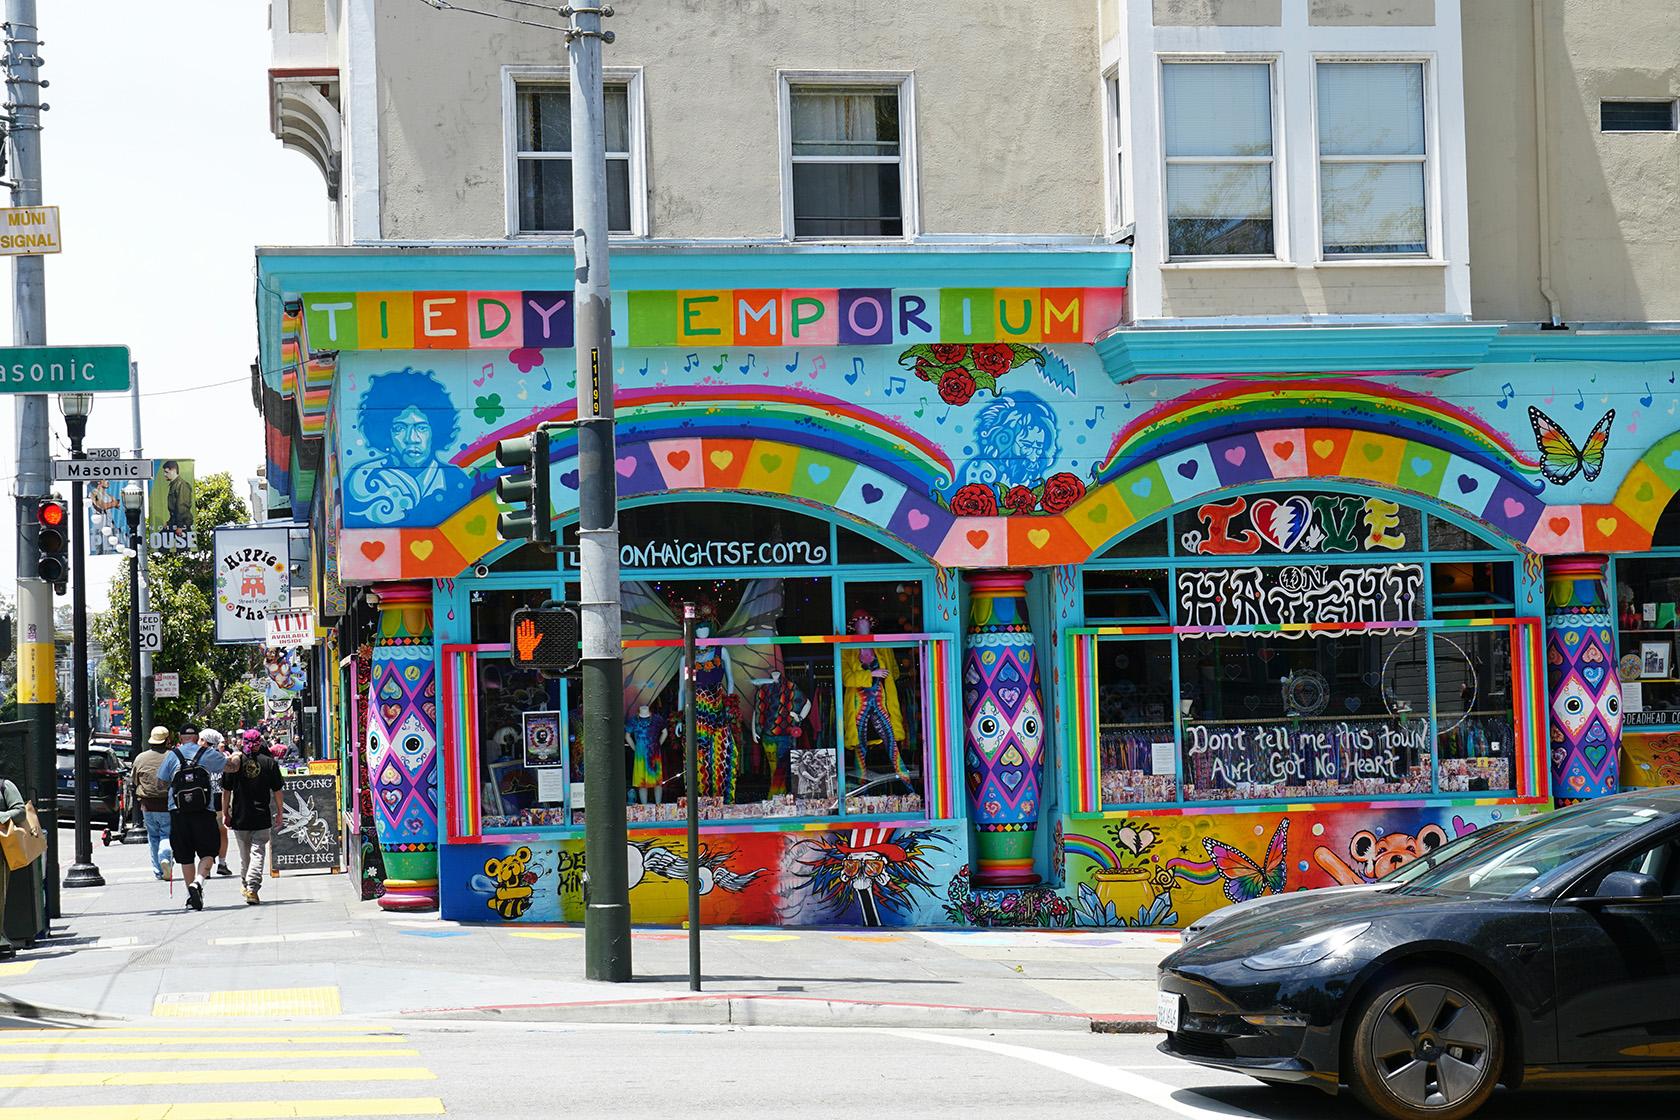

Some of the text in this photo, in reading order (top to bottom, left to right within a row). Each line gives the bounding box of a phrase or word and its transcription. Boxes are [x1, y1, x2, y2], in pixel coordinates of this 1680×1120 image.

[8, 213, 46, 226] MUNI
[1, 234, 57, 248] SIGNAL
[310, 295, 1080, 342] TIEDY EMPORIUM
[0, 358, 95, 382] asonic
[592, 351, 600, 413] T1199
[97, 449, 119, 459] 1200
[67, 463, 139, 477] Masonic
[1278, 565, 1329, 592] ON
[1177, 563, 1424, 642] HAIGHT
[272, 613, 307, 632] ATM
[138, 633, 158, 648] 20
[271, 632, 309, 640] AVAILABLE
[1626, 712, 1667, 725] DEADHEAD
[1255, 726, 1291, 749] tell
[1299, 733, 1331, 749] me
[1336, 722, 1373, 749] this
[1269, 751, 1306, 785] Got
[1315, 757, 1336, 777] No
[281, 779, 333, 790] TTOOING
[277, 853, 335, 865] PIERCING
